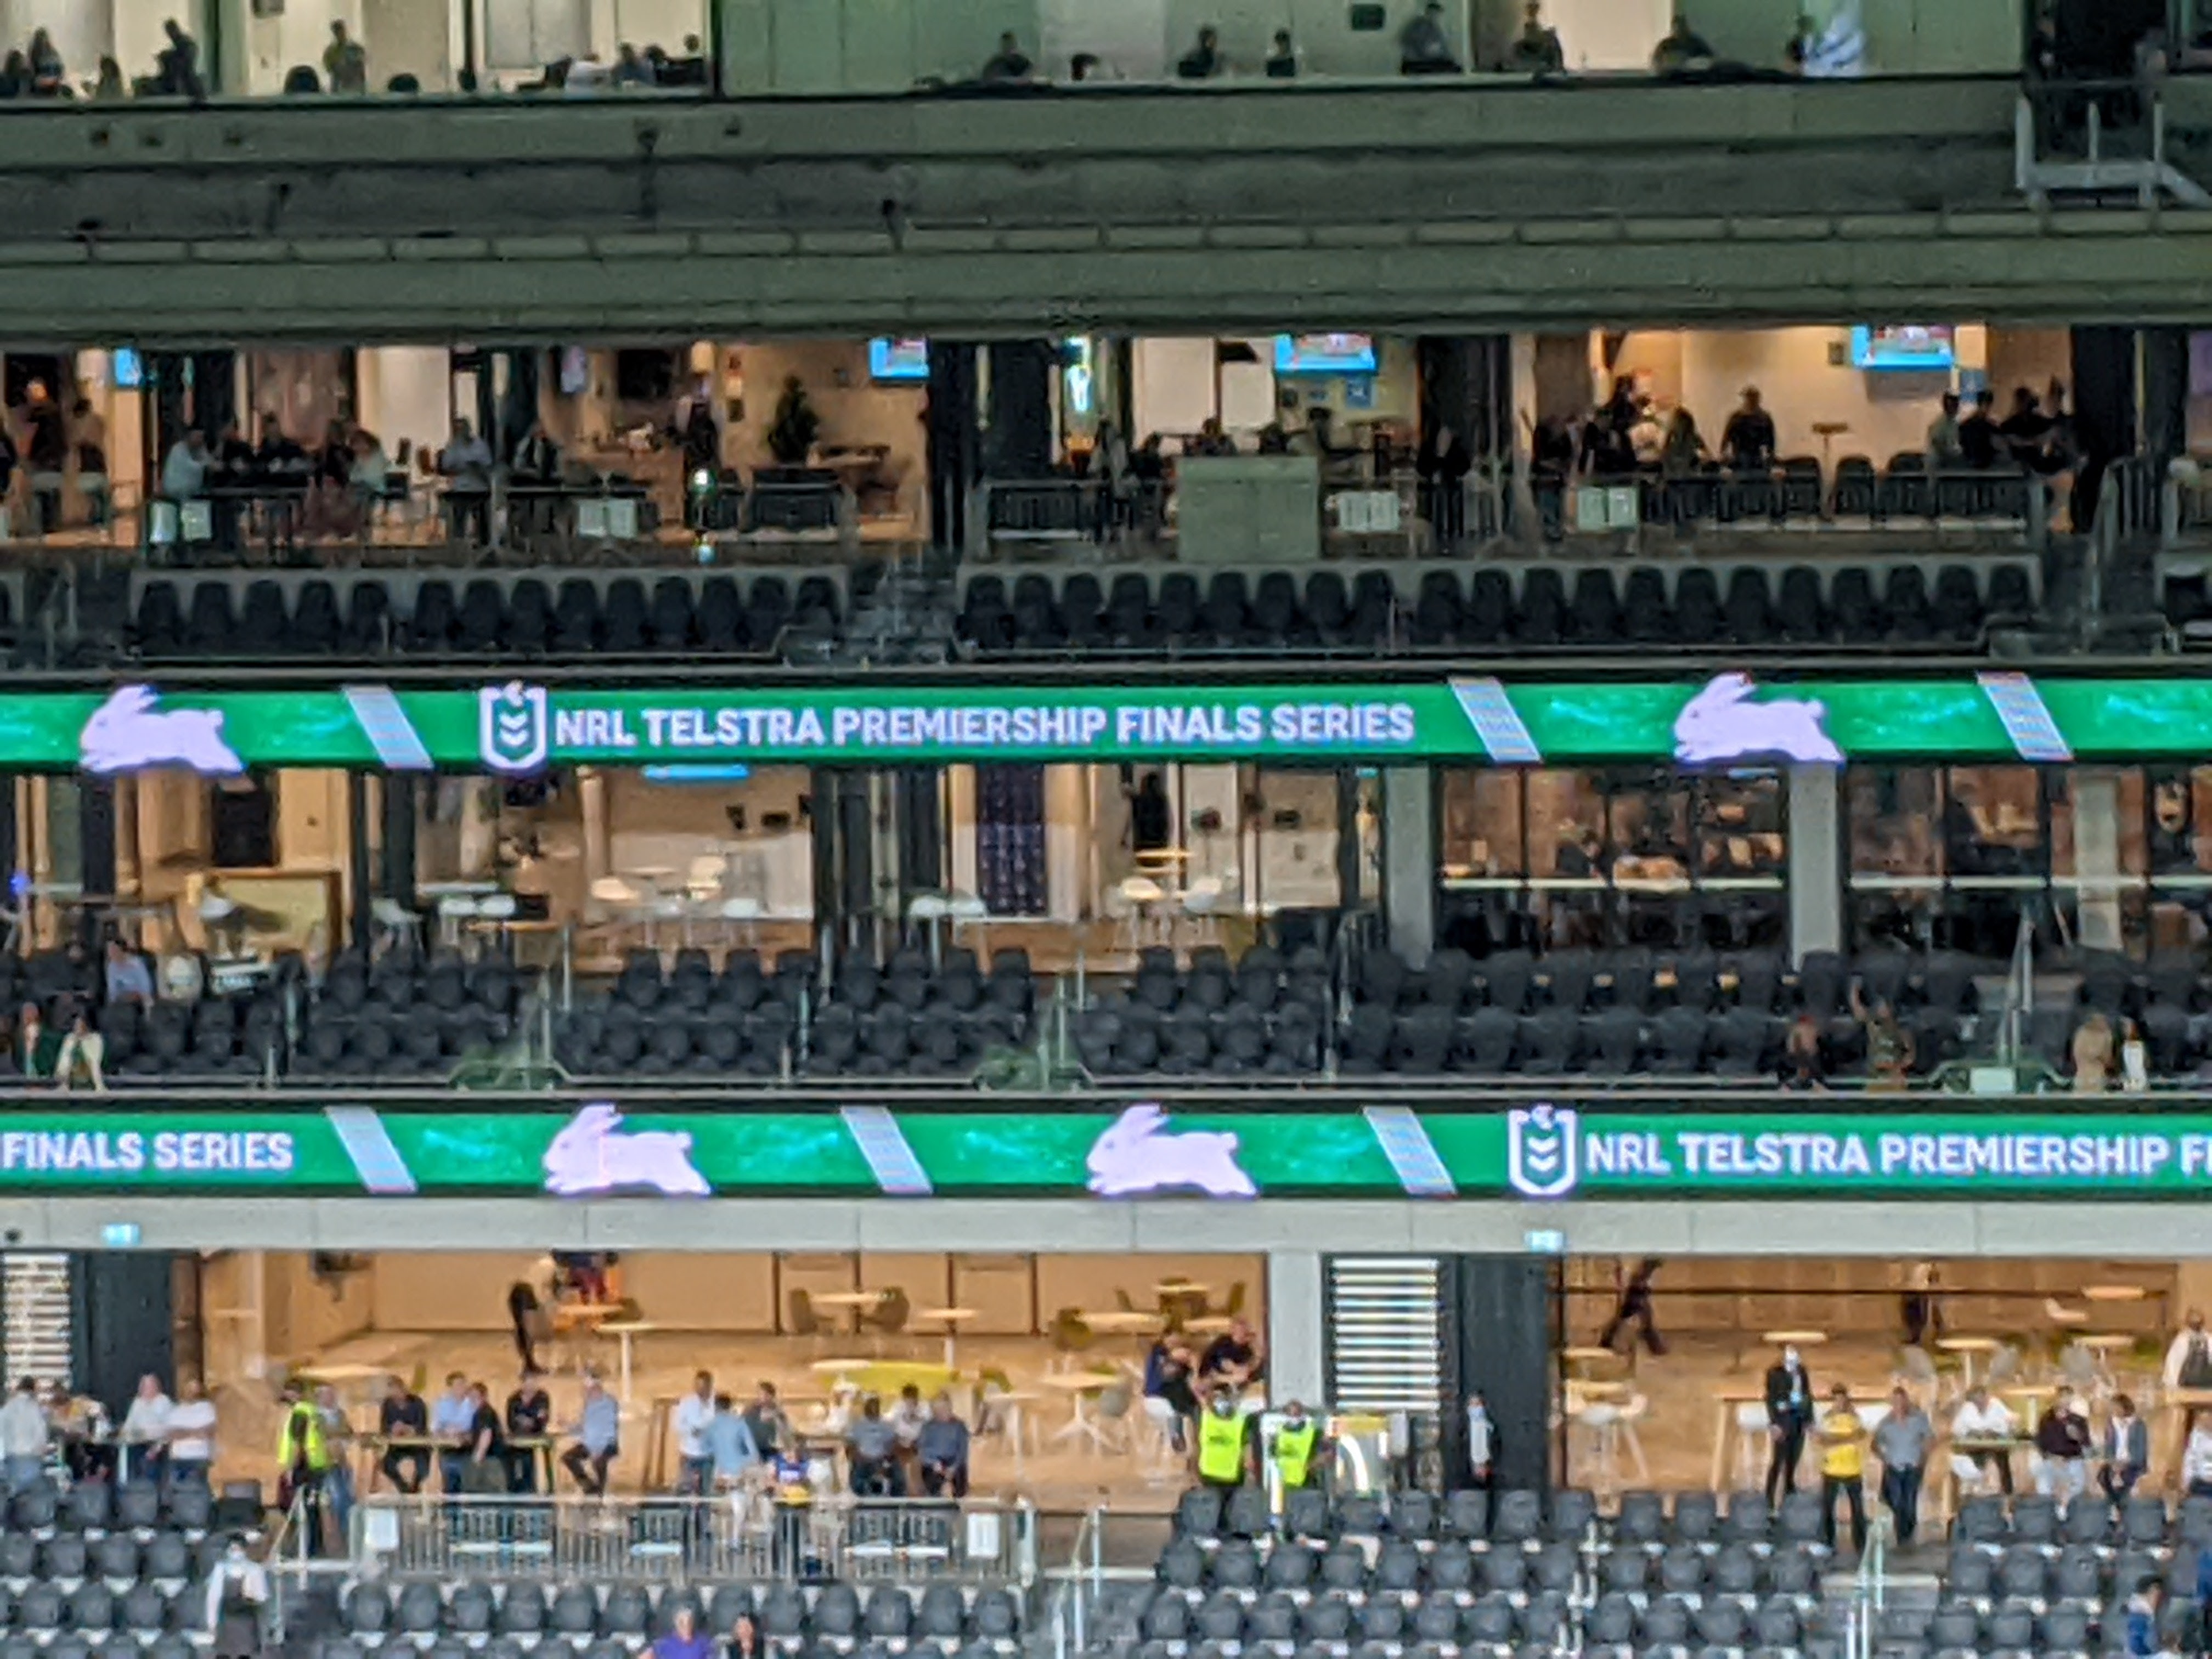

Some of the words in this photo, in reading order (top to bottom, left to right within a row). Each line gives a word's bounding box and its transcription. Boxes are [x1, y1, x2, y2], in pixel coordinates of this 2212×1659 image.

[554, 707, 636, 747] NRL
[641, 707, 825, 747] TELSTRA
[832, 706, 1107, 746] PREMIERSHIP
[1116, 704, 1262, 744] FINALS
[1271, 703, 1415, 742] SERIES
[3, 1131, 144, 1170] FINALS
[153, 1131, 295, 1170] SERIES
[1585, 1132, 1672, 1174] NRL
[1677, 1132, 1871, 1174] TELSTRA
[1878, 1133, 2170, 1175] PREMIERSHIP
